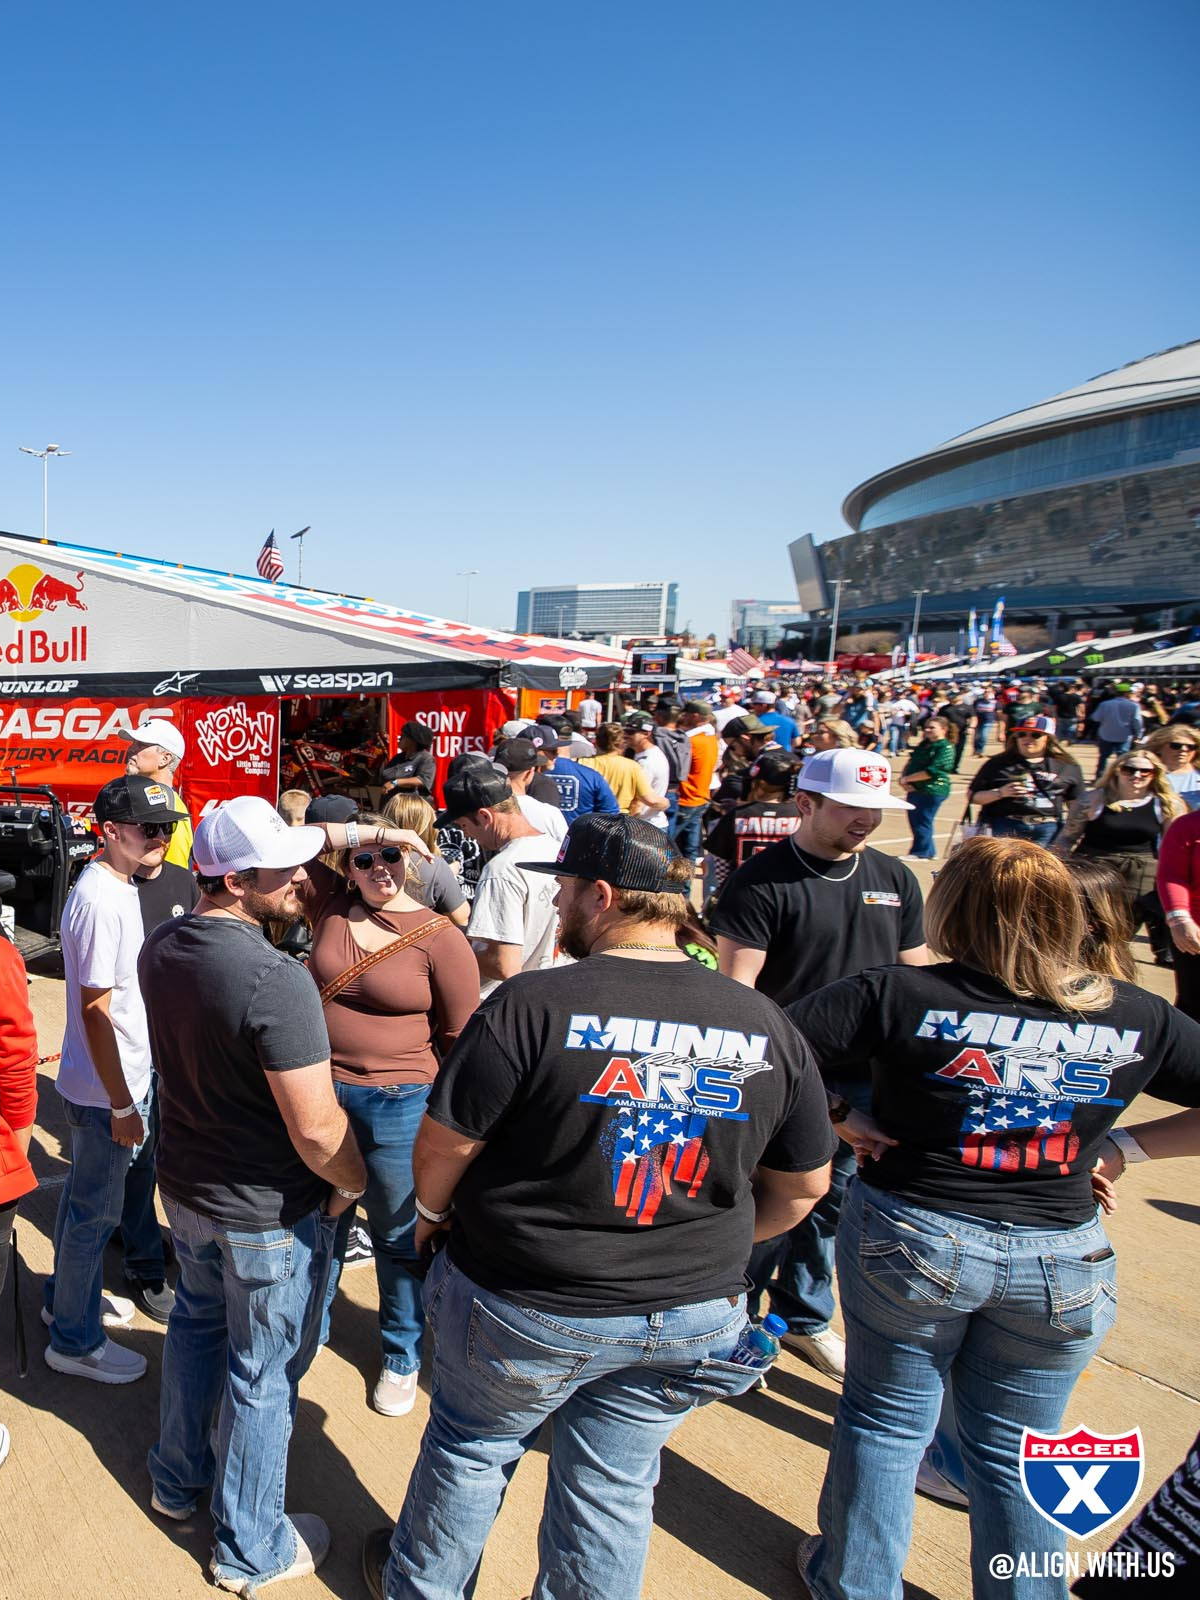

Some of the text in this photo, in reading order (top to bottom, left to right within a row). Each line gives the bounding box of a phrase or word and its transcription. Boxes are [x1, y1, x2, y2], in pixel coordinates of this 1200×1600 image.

[30, 626, 88, 663] Bull
[293, 671, 393, 691] seaspan
[416, 711, 466, 733] SONY
[67, 748, 130, 765] RACI
[564, 1014, 769, 1061] MUNN
[914, 1010, 1143, 1055] MUNN
[628, 1051, 773, 1079] Racing
[935, 1047, 1112, 1098] ARS
[589, 1057, 743, 1111] ARS
[964, 1082, 1092, 1104] AMATEUR RACE SUPPORT
[614, 1099, 724, 1118] AMATEUR RACE SUPPORT
